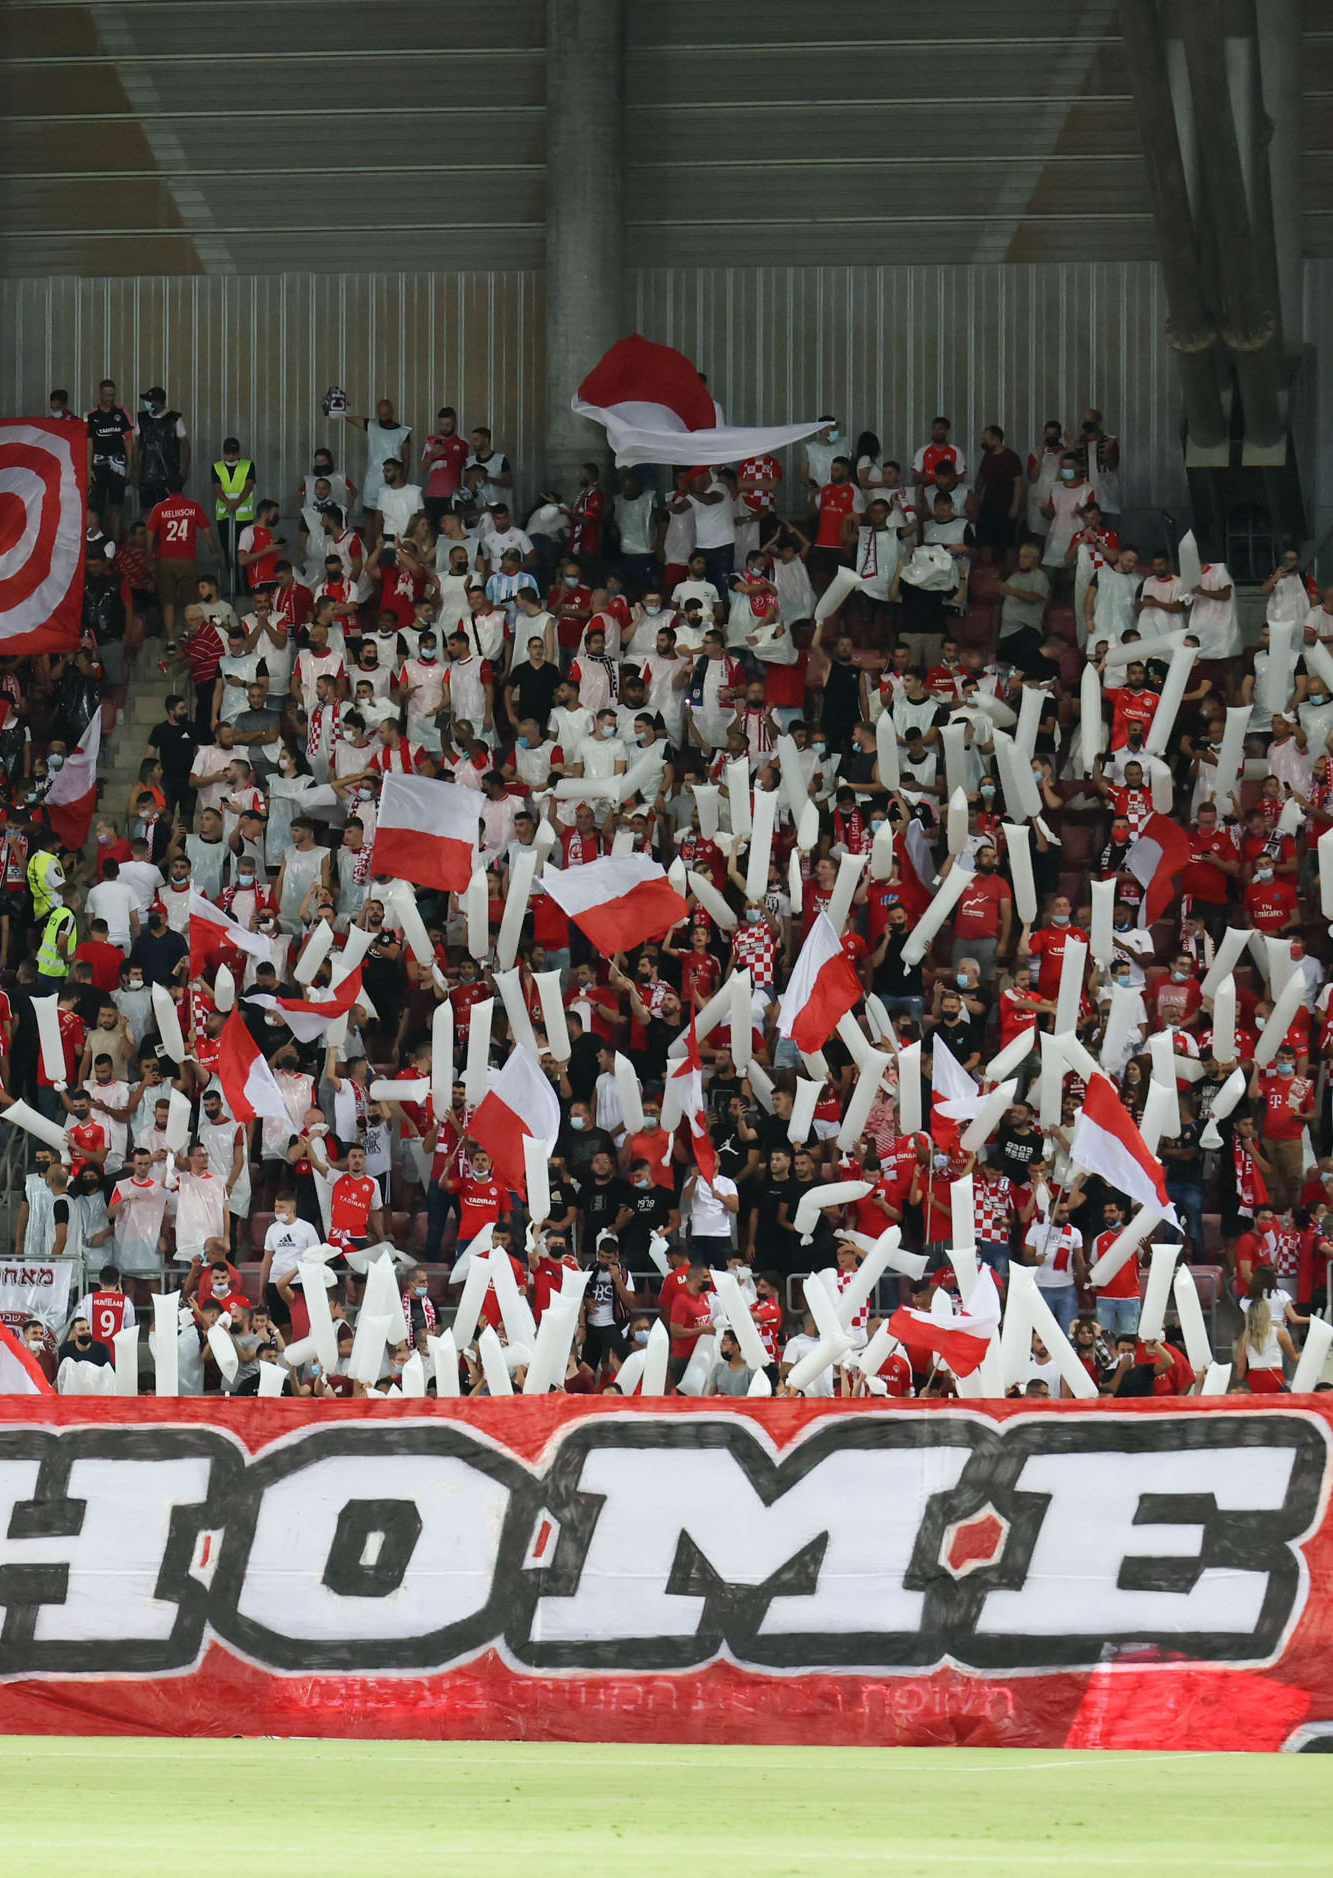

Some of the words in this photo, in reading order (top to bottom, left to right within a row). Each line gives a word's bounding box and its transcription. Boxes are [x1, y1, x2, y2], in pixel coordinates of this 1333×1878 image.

[161, 509, 196, 519] MELIKSON
[167, 519, 188, 541] 24
[339, 1194, 367, 1209] TADIRAN
[468, 1196, 497, 1207] TADIRAN
[100, 1309, 116, 1337] 9
